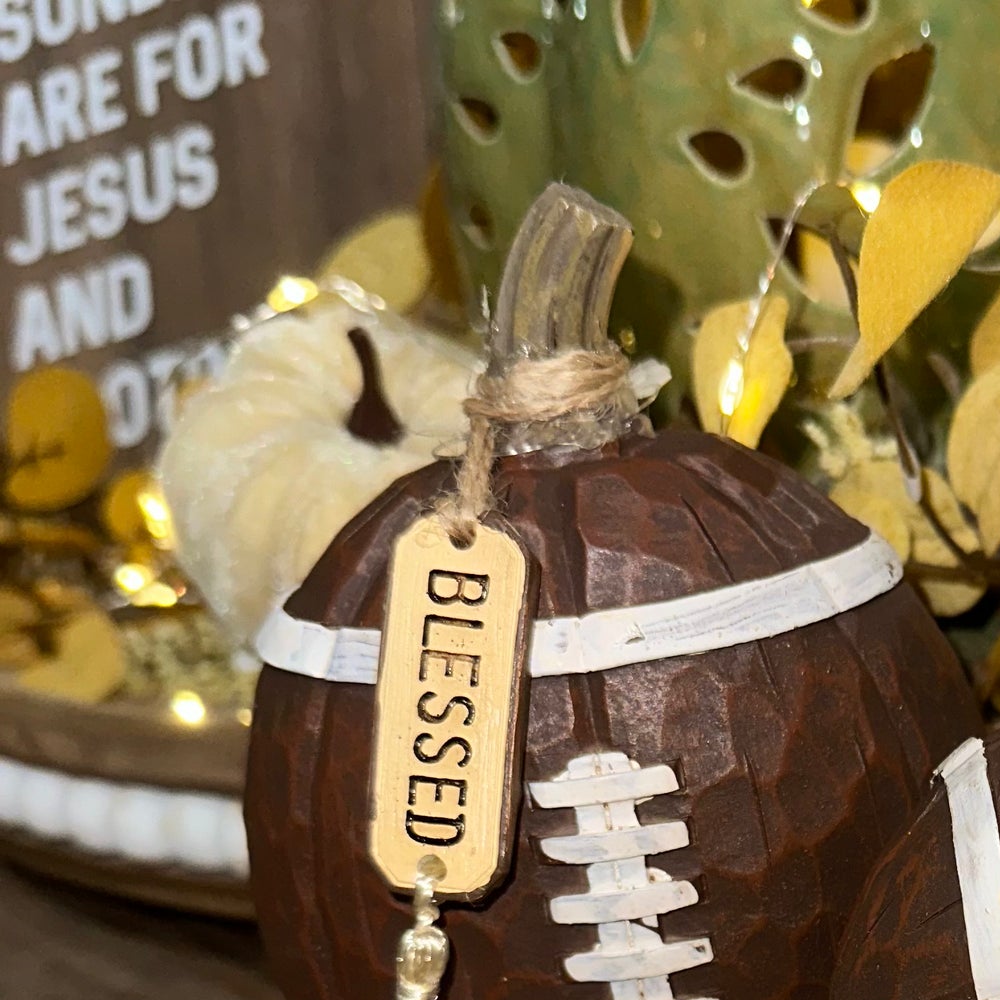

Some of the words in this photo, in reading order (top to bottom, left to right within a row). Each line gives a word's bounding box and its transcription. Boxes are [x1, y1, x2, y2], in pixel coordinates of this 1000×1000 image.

[0, 0, 165, 62] SU
[1, 48, 127, 166] ARE
[133, 2, 269, 116] FOR
[7, 123, 218, 265] JESUS
[12, 253, 153, 371] AND
[404, 568, 491, 847] BLESSED
